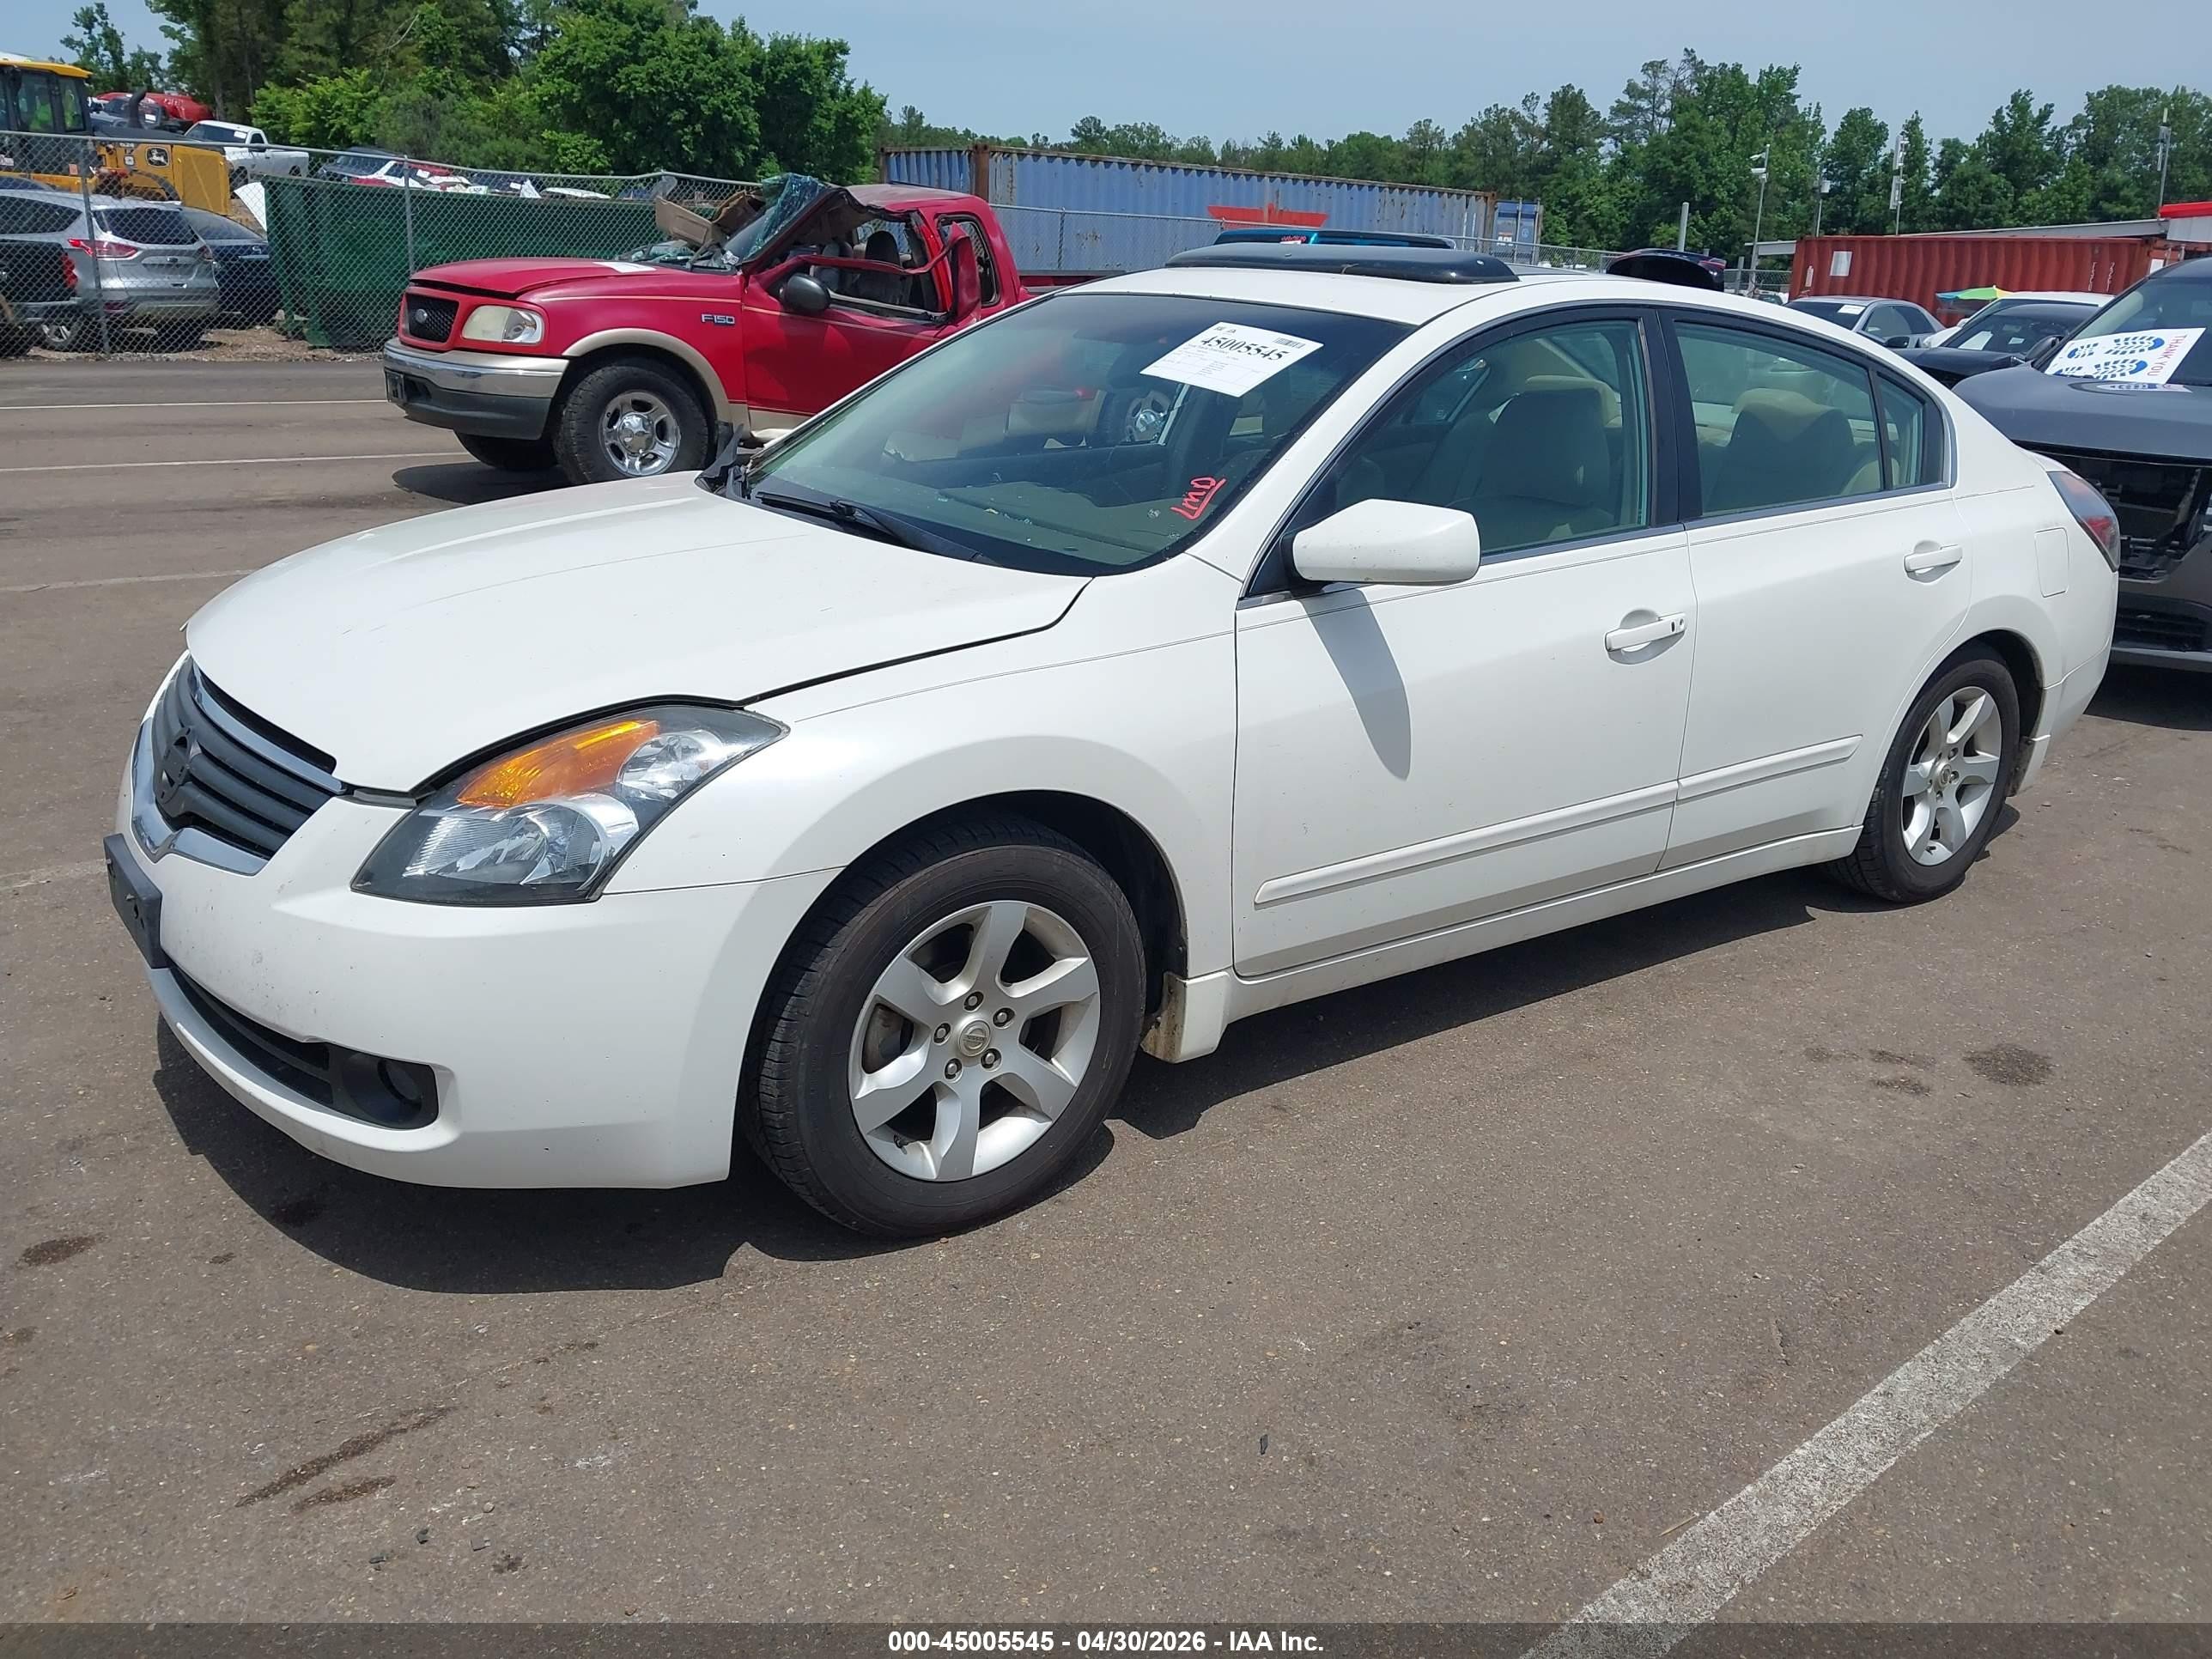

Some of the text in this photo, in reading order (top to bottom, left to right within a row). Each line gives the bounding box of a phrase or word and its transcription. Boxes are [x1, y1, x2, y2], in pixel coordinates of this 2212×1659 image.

[701, 313, 735, 325] F150
[1201, 336, 1289, 361] 45005545
[2147, 335, 2186, 377] THANK YOU
